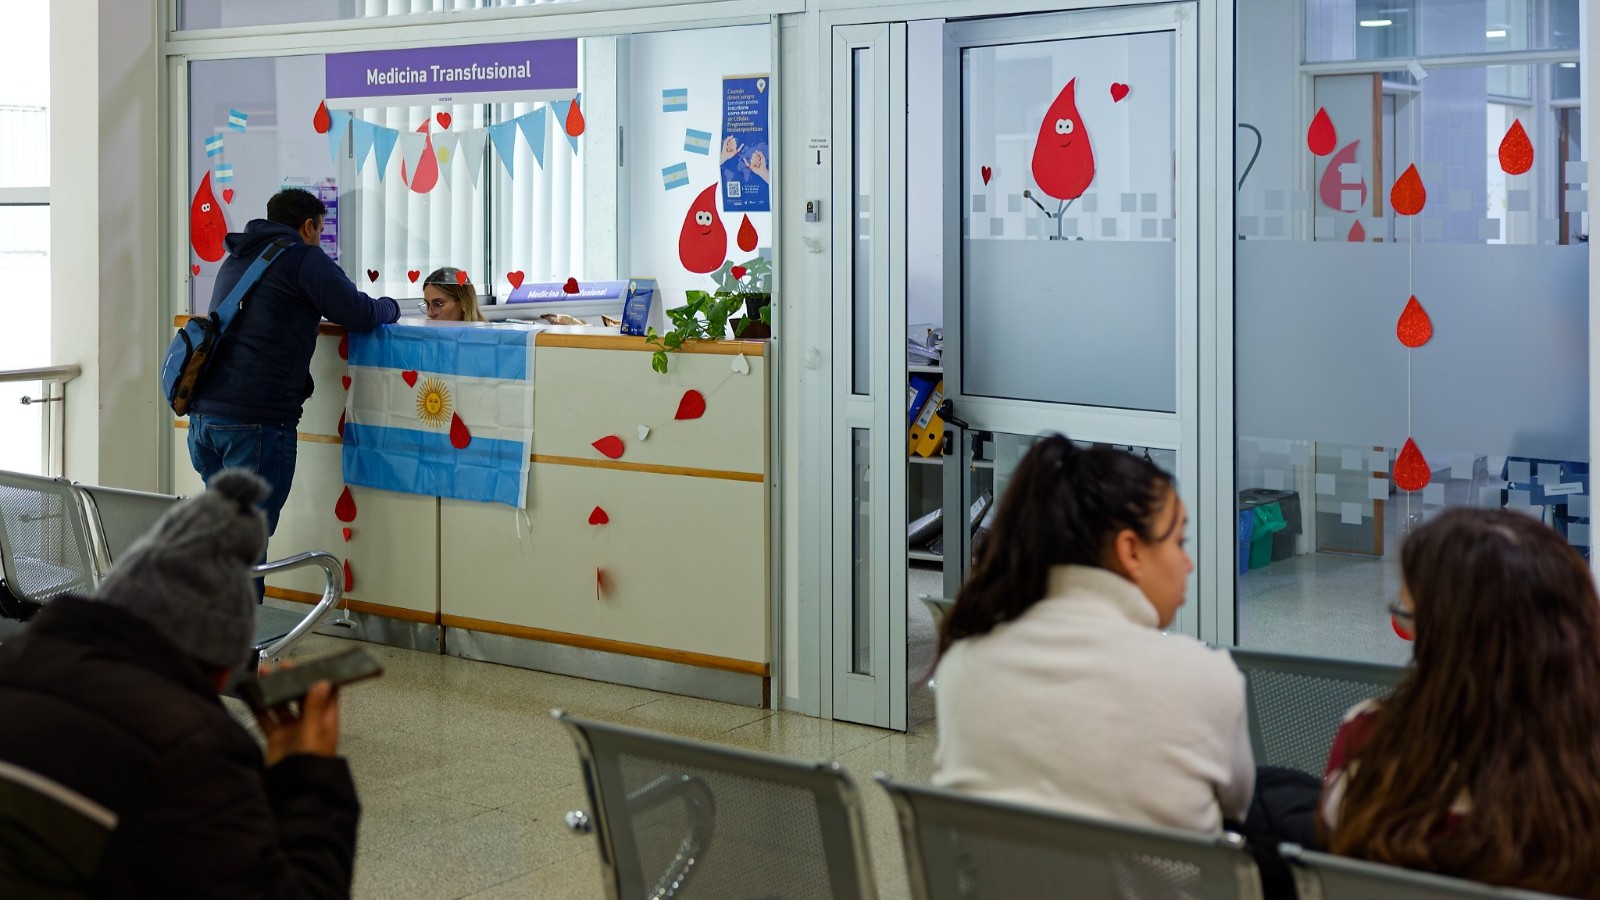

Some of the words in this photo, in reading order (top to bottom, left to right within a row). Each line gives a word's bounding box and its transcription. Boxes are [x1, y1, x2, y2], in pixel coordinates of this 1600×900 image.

[367, 67, 427, 85] Medicina
[431, 61, 531, 82] Transfusional
[527, 290, 559, 298] Medicina
